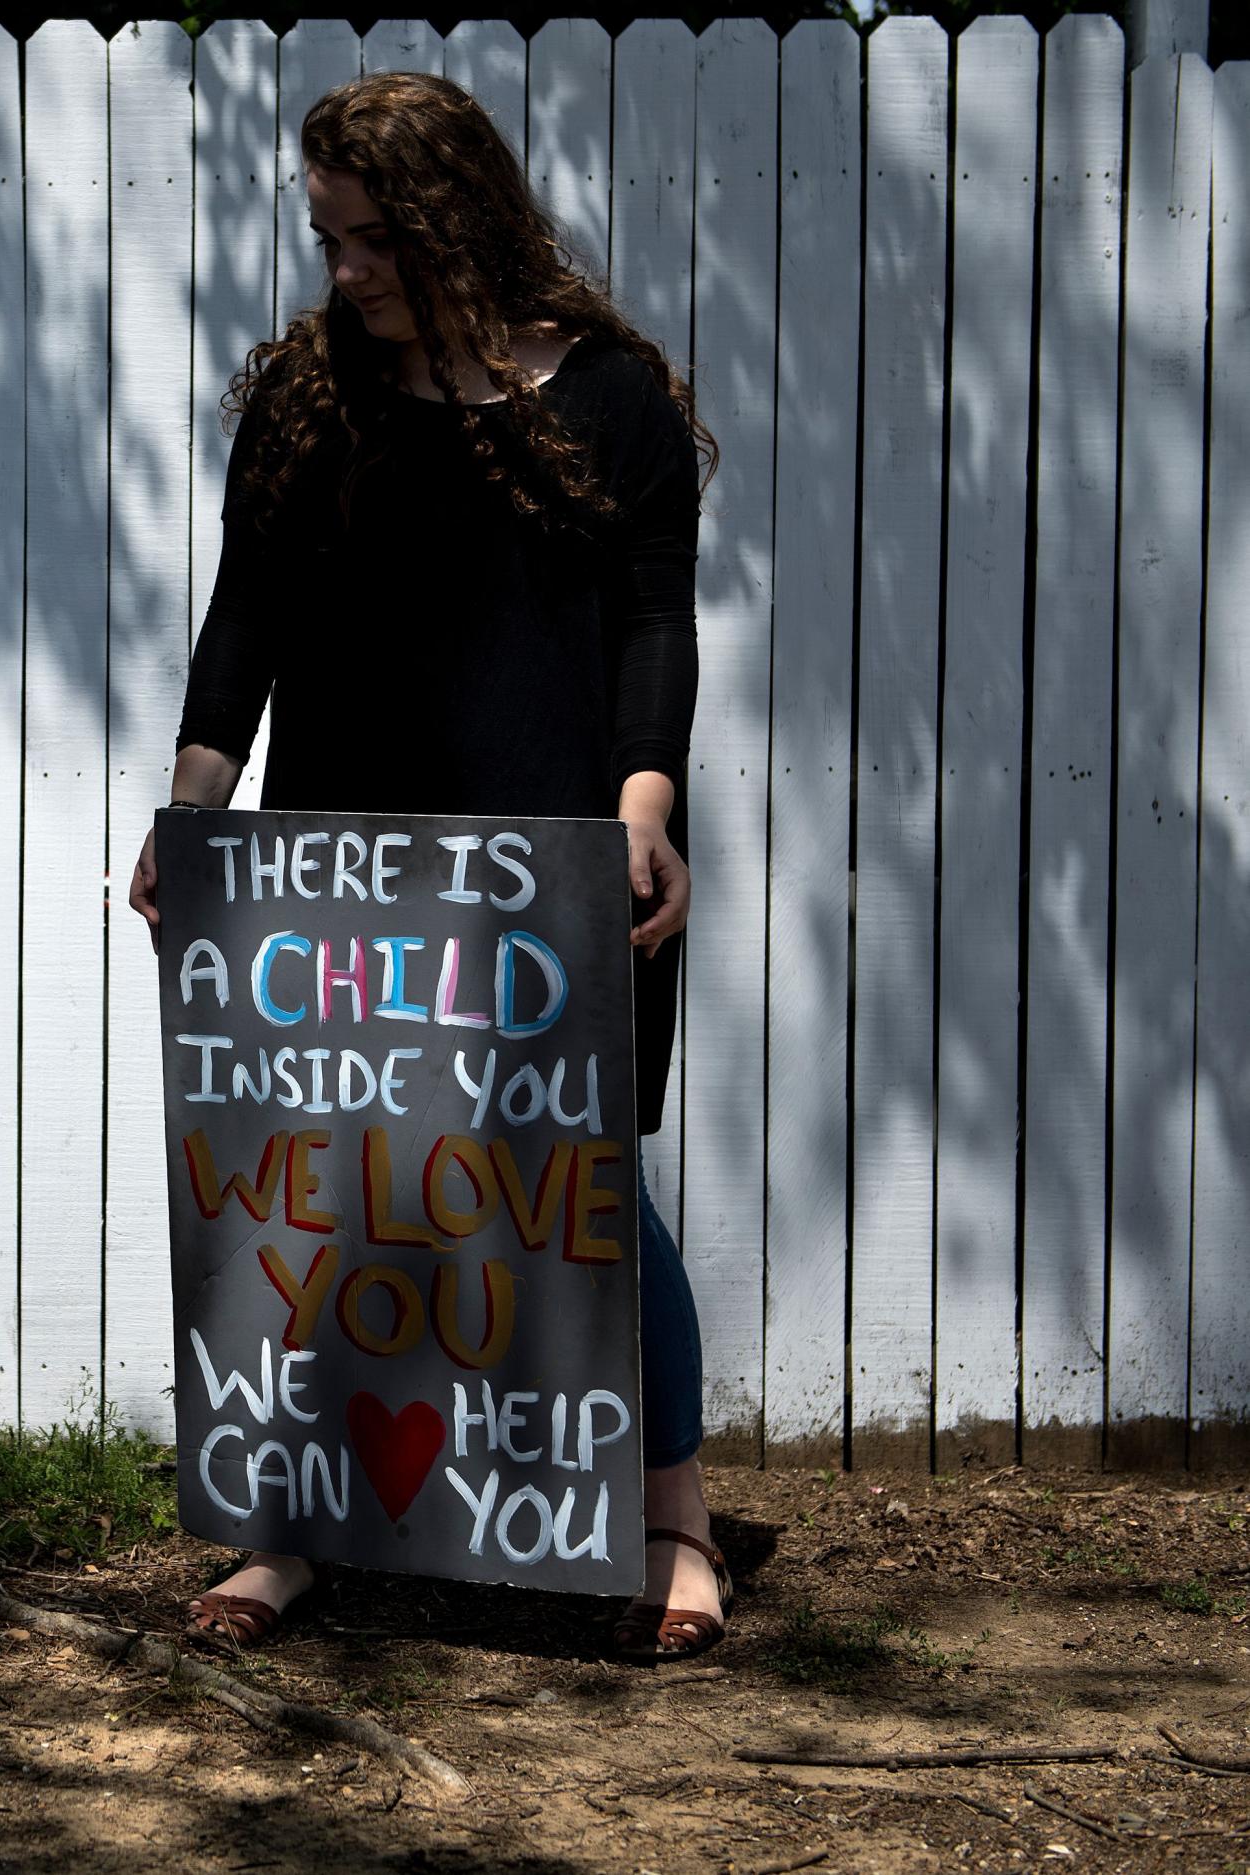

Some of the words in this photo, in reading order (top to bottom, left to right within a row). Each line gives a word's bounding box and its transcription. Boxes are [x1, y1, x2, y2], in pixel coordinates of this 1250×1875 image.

[207, 831, 412, 904] THERE
[437, 831, 536, 912] IS
[180, 938, 229, 1008] A
[251, 929, 570, 1039] CHILD
[175, 1033, 422, 1116] INSIDE
[454, 1048, 602, 1135] YOU
[183, 1127, 340, 1234] WE
[361, 1126, 624, 1265] LOVE
[257, 1244, 516, 1370] YOU
[190, 1328, 320, 1424] WE
[453, 1379, 631, 1472] HELP
[199, 1424, 350, 1522] CAN
[445, 1467, 612, 1566] YOU
